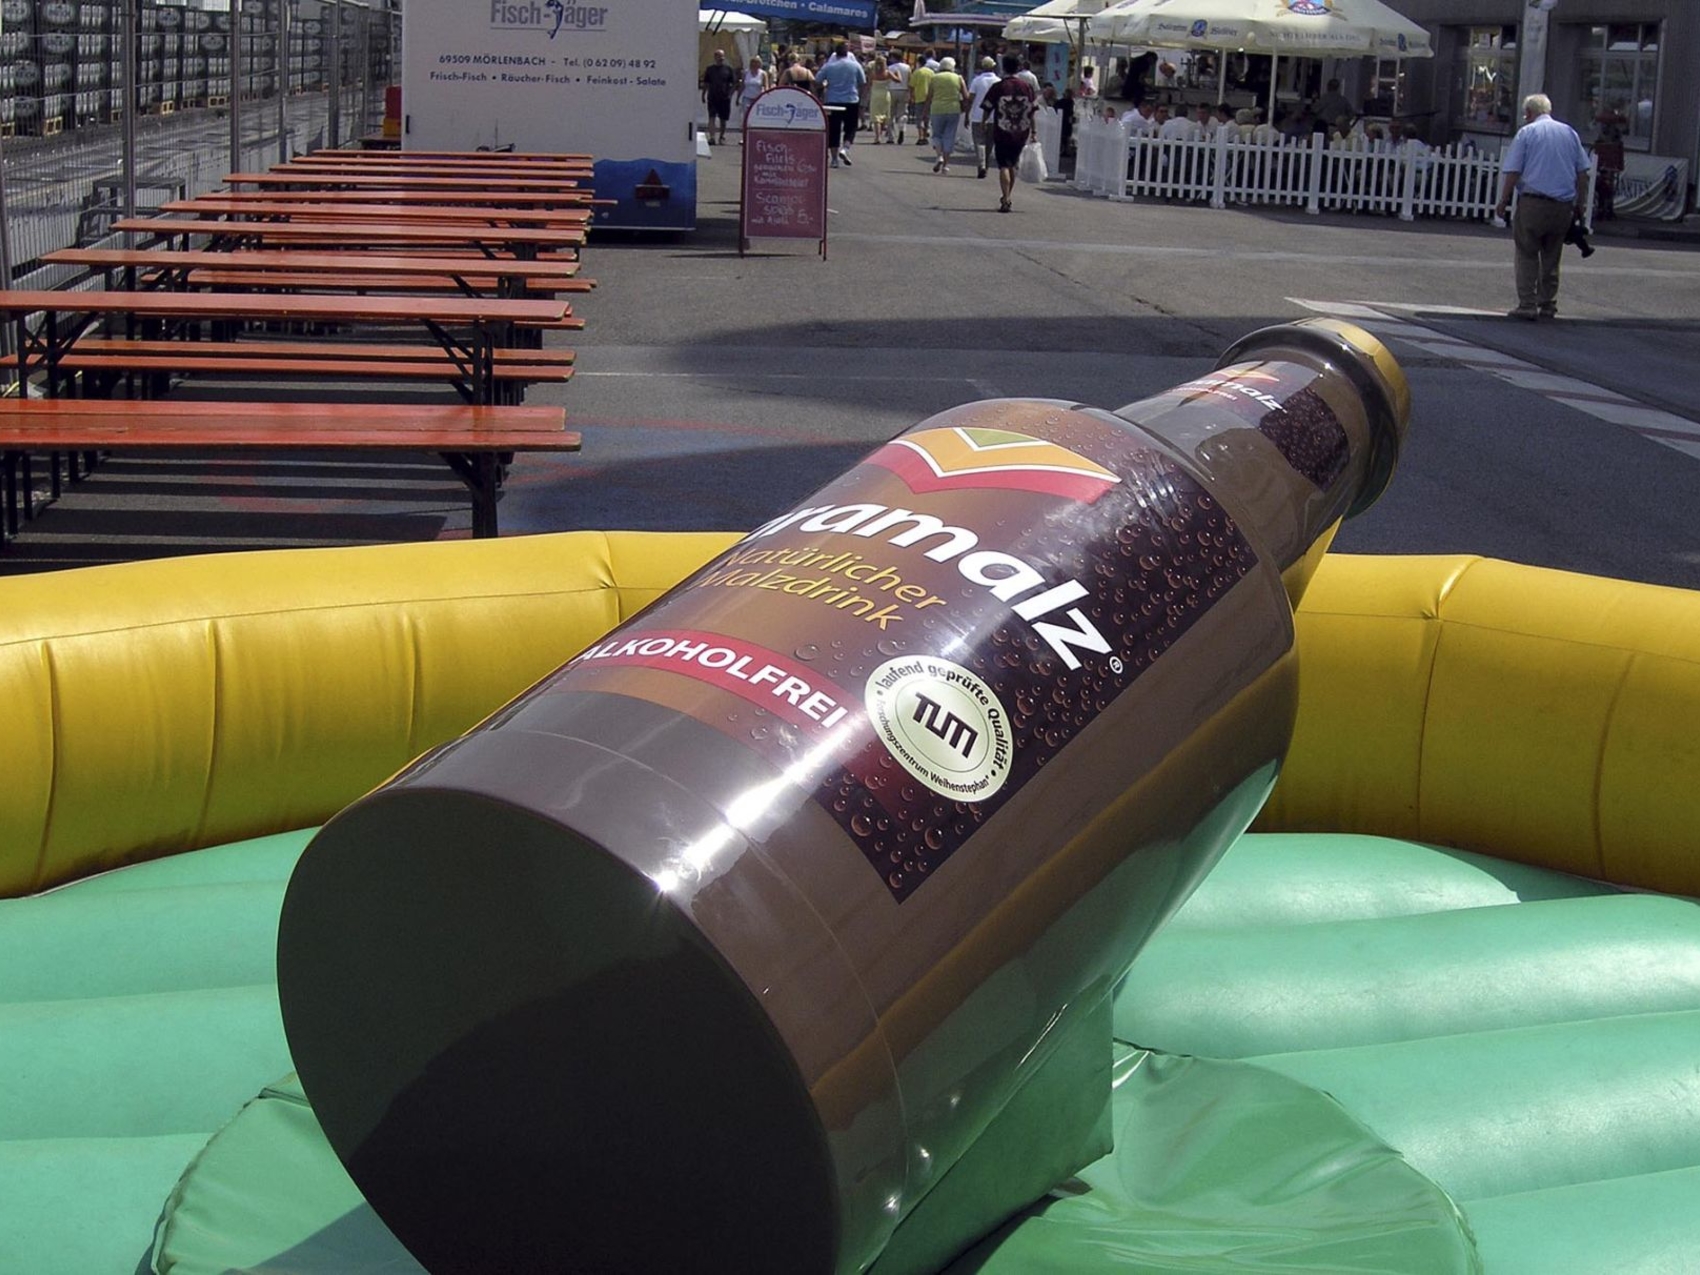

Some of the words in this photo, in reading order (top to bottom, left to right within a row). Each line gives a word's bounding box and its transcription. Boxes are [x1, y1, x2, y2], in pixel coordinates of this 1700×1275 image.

[808, 1, 869, 19] Calamares
[438, 54, 471, 64] 69509
[472, 53, 546, 66] MÖRLENBACH
[692, 567, 905, 631] Malzdrink
[726, 546, 948, 611] Natürlicher
[742, 503, 1113, 671] ramalz
[568, 637, 849, 729] ALKOHOLFREI
[875, 660, 925, 690] laufend
[927, 663, 989, 706] geprüfte
[987, 707, 1009, 771] Qualität
